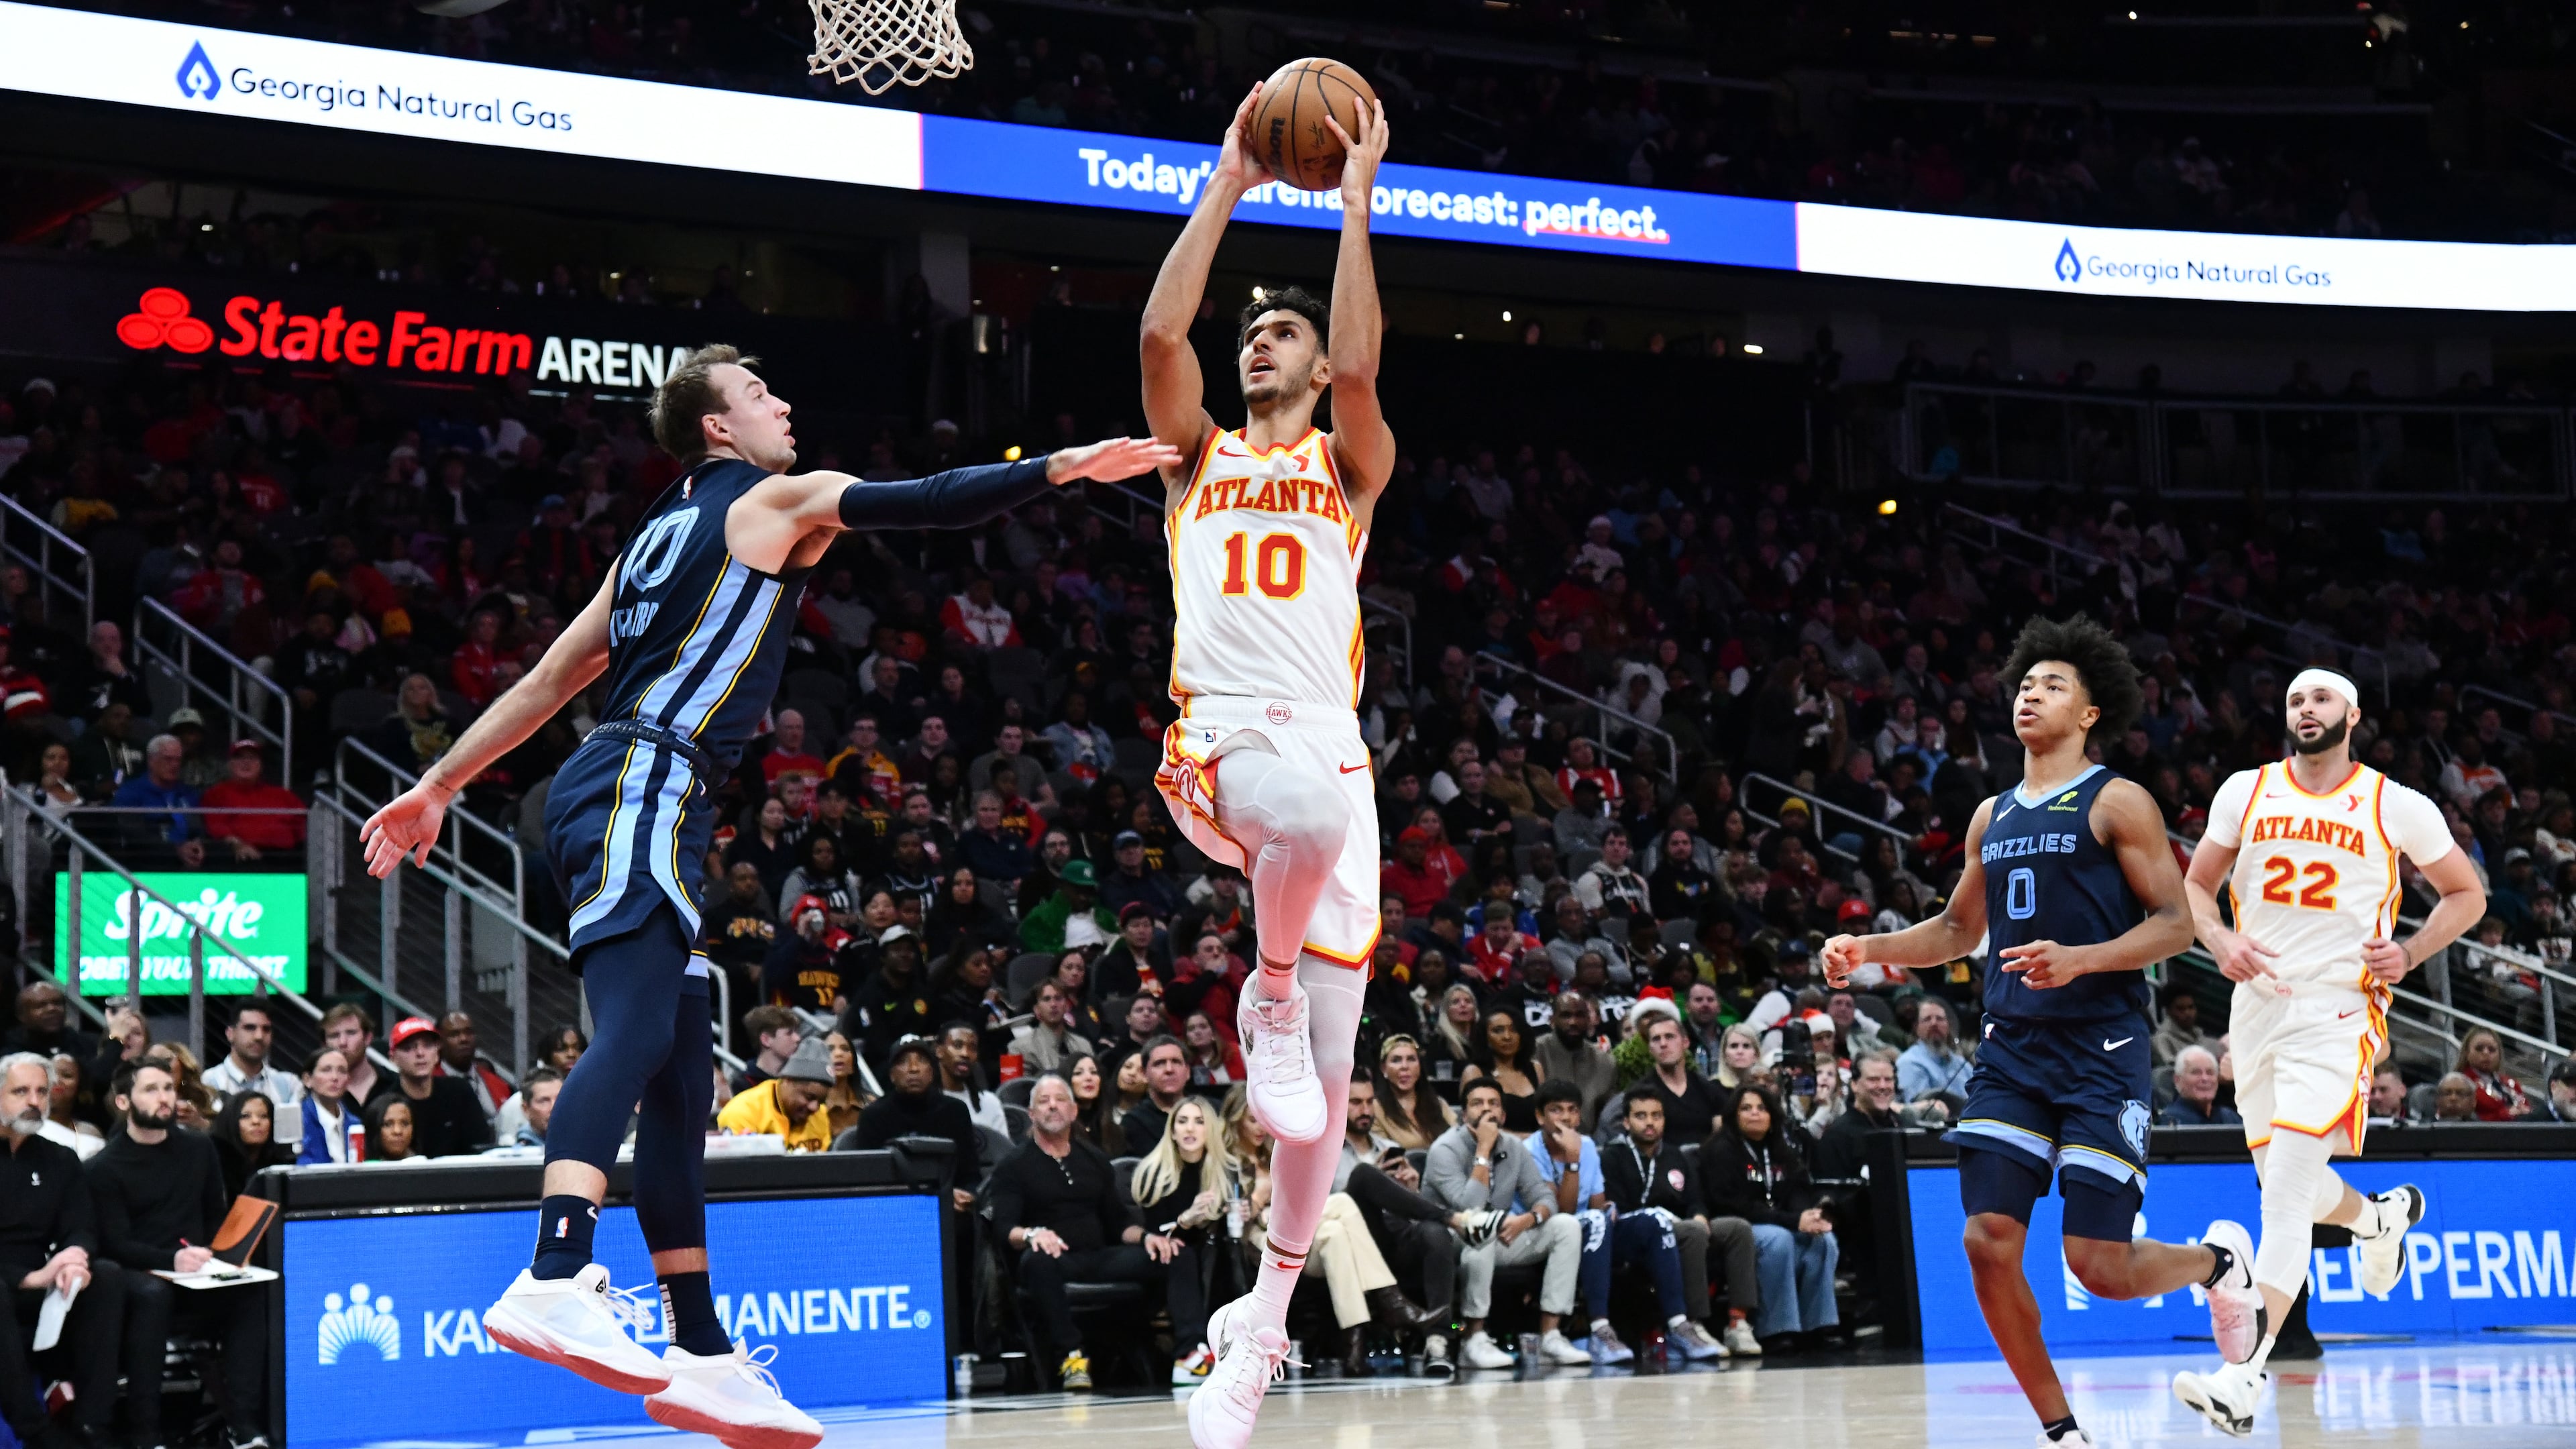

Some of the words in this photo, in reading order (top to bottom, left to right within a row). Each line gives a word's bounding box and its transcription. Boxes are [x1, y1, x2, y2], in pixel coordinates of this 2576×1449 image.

[231, 68, 366, 112] Georgia
[378, 85, 502, 124] Natural
[513, 102, 574, 131] Gas
[1079, 148, 1216, 204] Today'
[1370, 186, 1519, 227] orecast:
[1525, 197, 1668, 240] perfect.
[2087, 255, 2180, 285] Georgia
[2187, 261, 2279, 285] Natural
[2285, 265, 2332, 287] Gas
[219, 296, 380, 366] State
[387, 311, 533, 376] Farm
[1194, 477, 1342, 526] ATLANTA
[619, 506, 700, 599] 10
[1222, 531, 1307, 601] 10
[1265, 708, 1292, 718] HAWKS
[1981, 833, 2077, 865] GRIZZLIES
[2252, 816, 2365, 858] ATLANTA
[2006, 867, 2036, 920] 0
[2263, 855, 2340, 911] 22
[105, 888, 264, 948] Sprite
[140, 956, 193, 979] YOU
